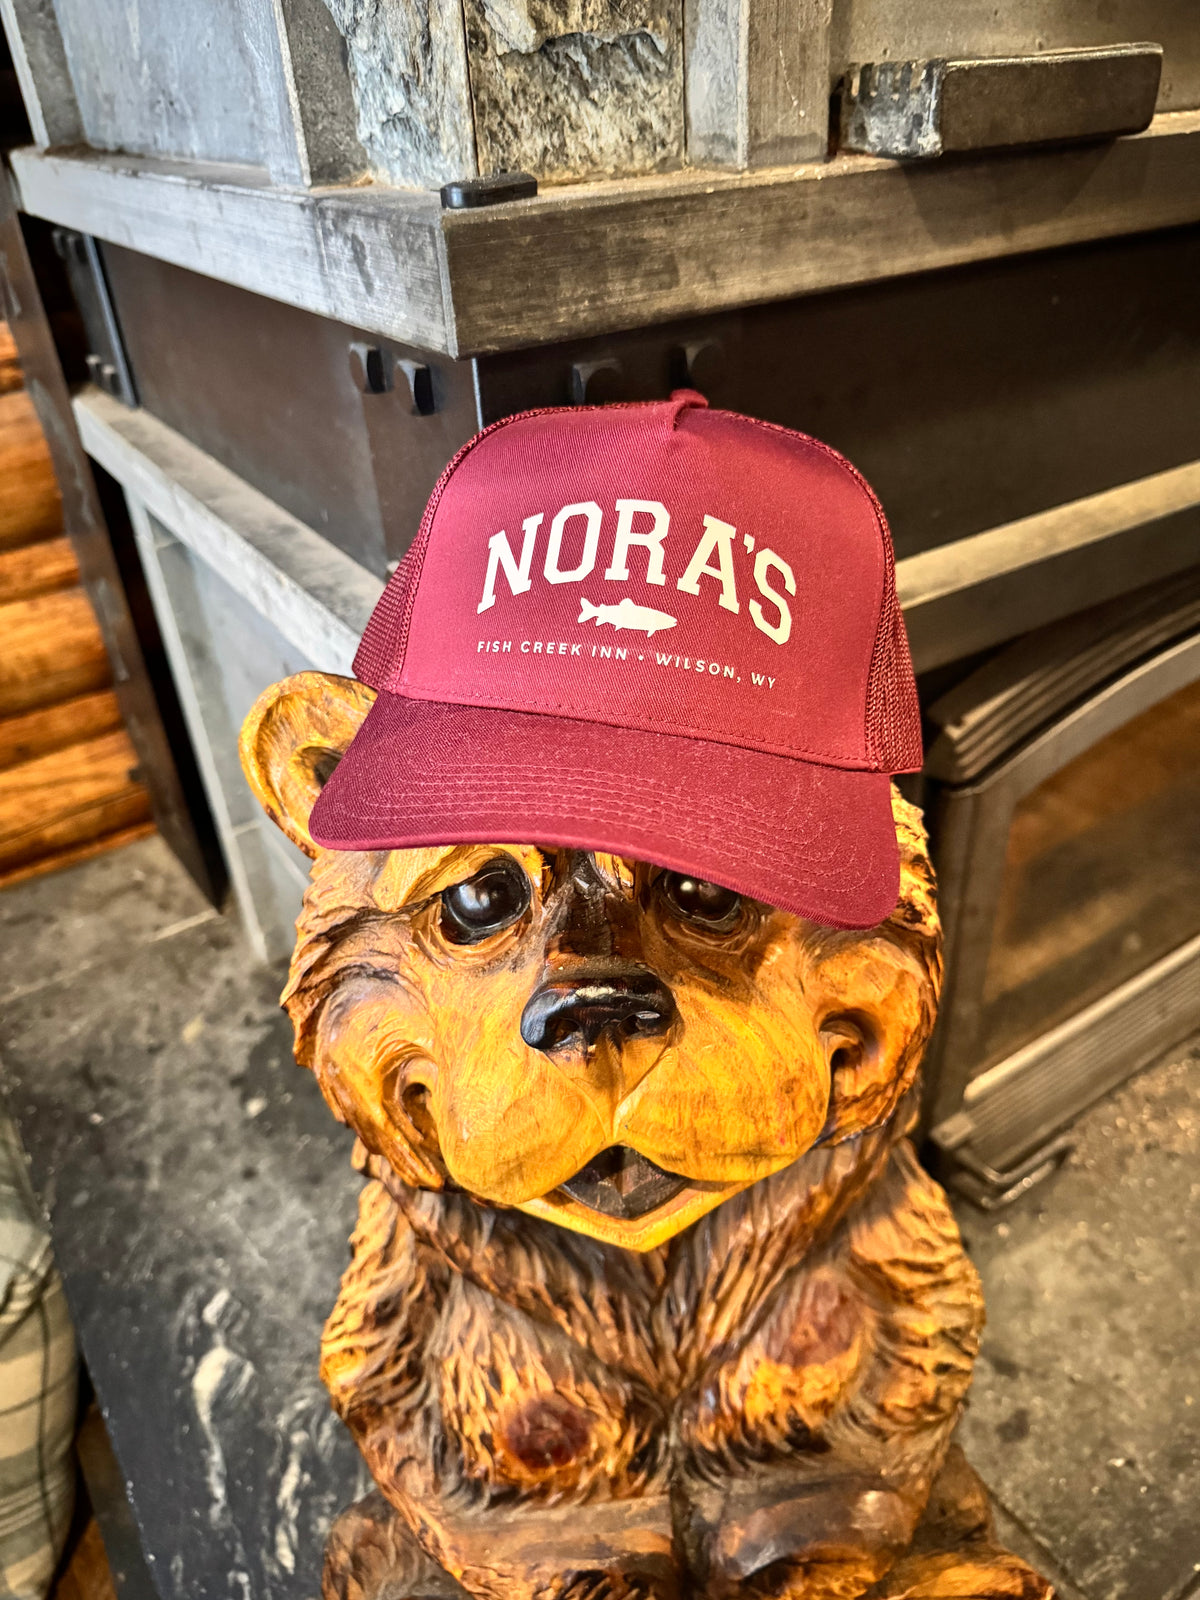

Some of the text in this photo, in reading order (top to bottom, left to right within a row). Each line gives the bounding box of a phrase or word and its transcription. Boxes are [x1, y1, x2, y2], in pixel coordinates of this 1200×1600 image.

[477, 498, 797, 646] NORA'S
[477, 640, 777, 690] FISH CREEK INN WILSON, WY
